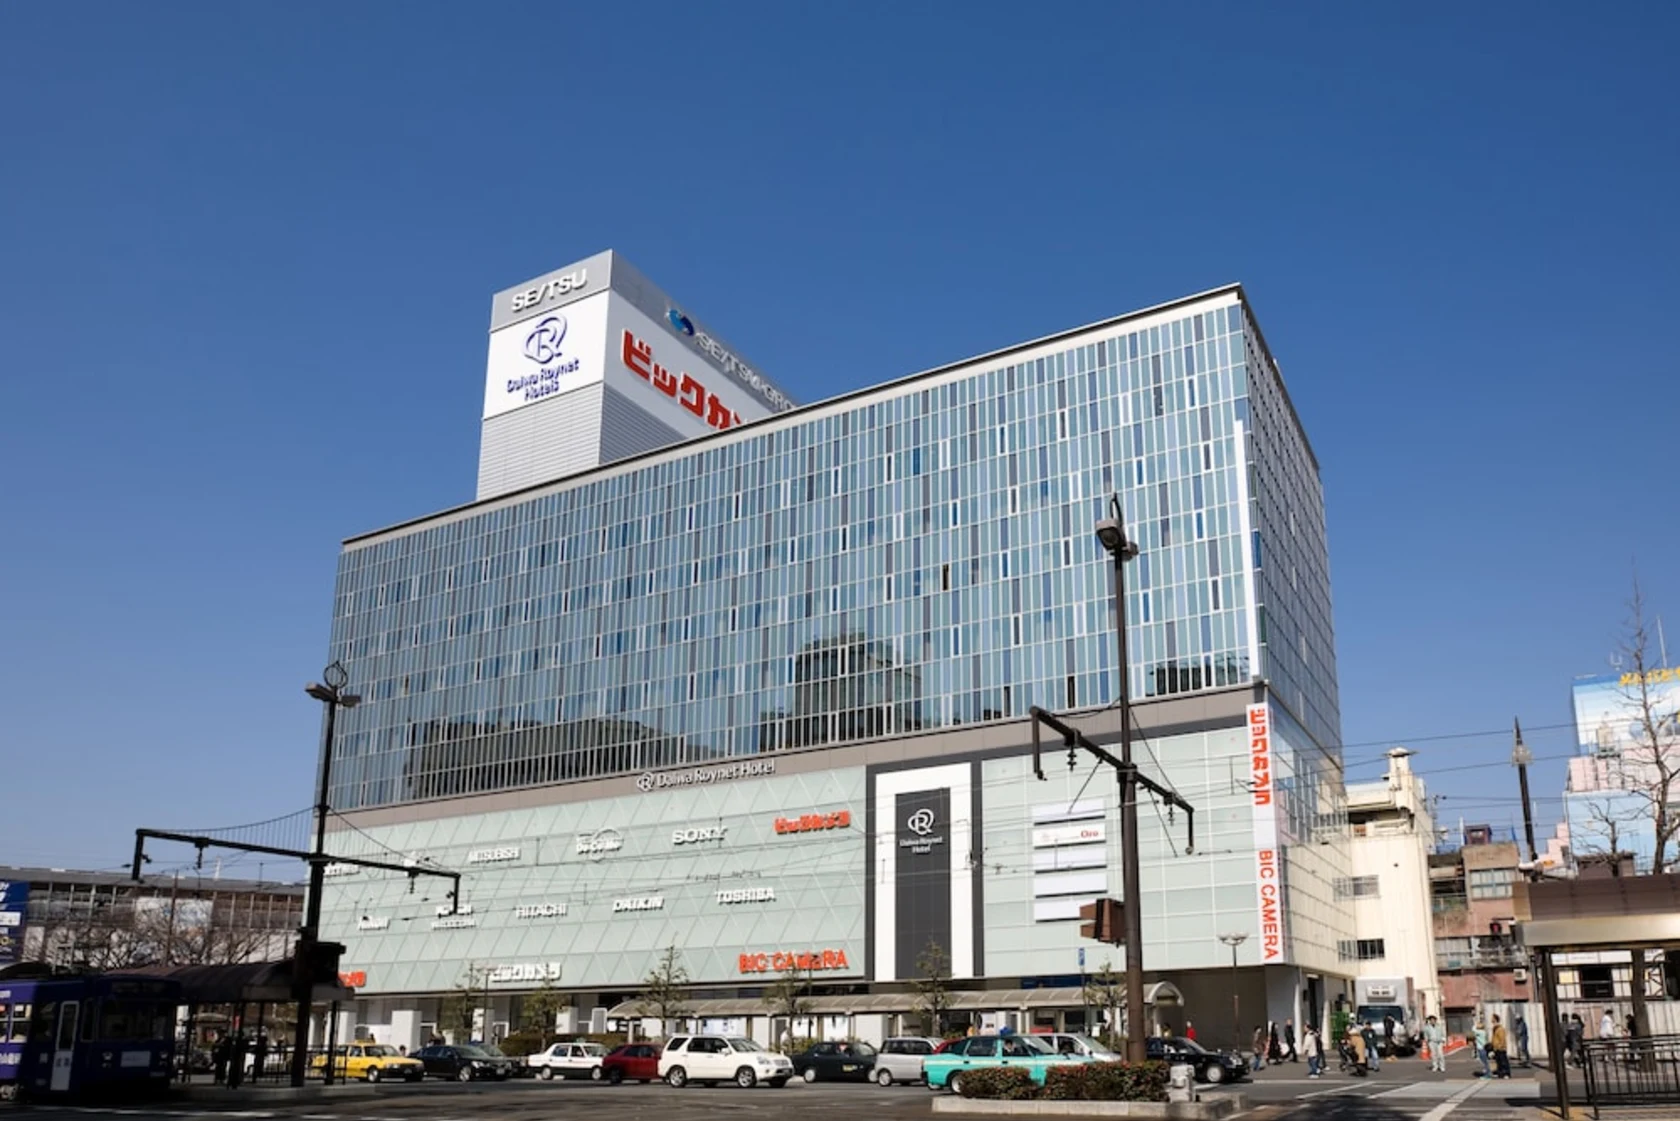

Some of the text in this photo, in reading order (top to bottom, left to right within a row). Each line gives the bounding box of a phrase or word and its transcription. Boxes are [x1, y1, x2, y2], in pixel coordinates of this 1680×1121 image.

[507, 357, 580, 394] Daiwa Roynet
[621, 328, 742, 430] ビックカ
[1250, 708, 1271, 805] ビックカメラ
[656, 772, 692, 789] Daiwa
[694, 764, 739, 786] Roynet
[741, 759, 776, 778] Hotel
[672, 826, 728, 845] SONY
[717, 887, 776, 905] TOSHIBA
[1258, 850, 1279, 960] BIC CAMERA
[738, 952, 769, 974] BIC
